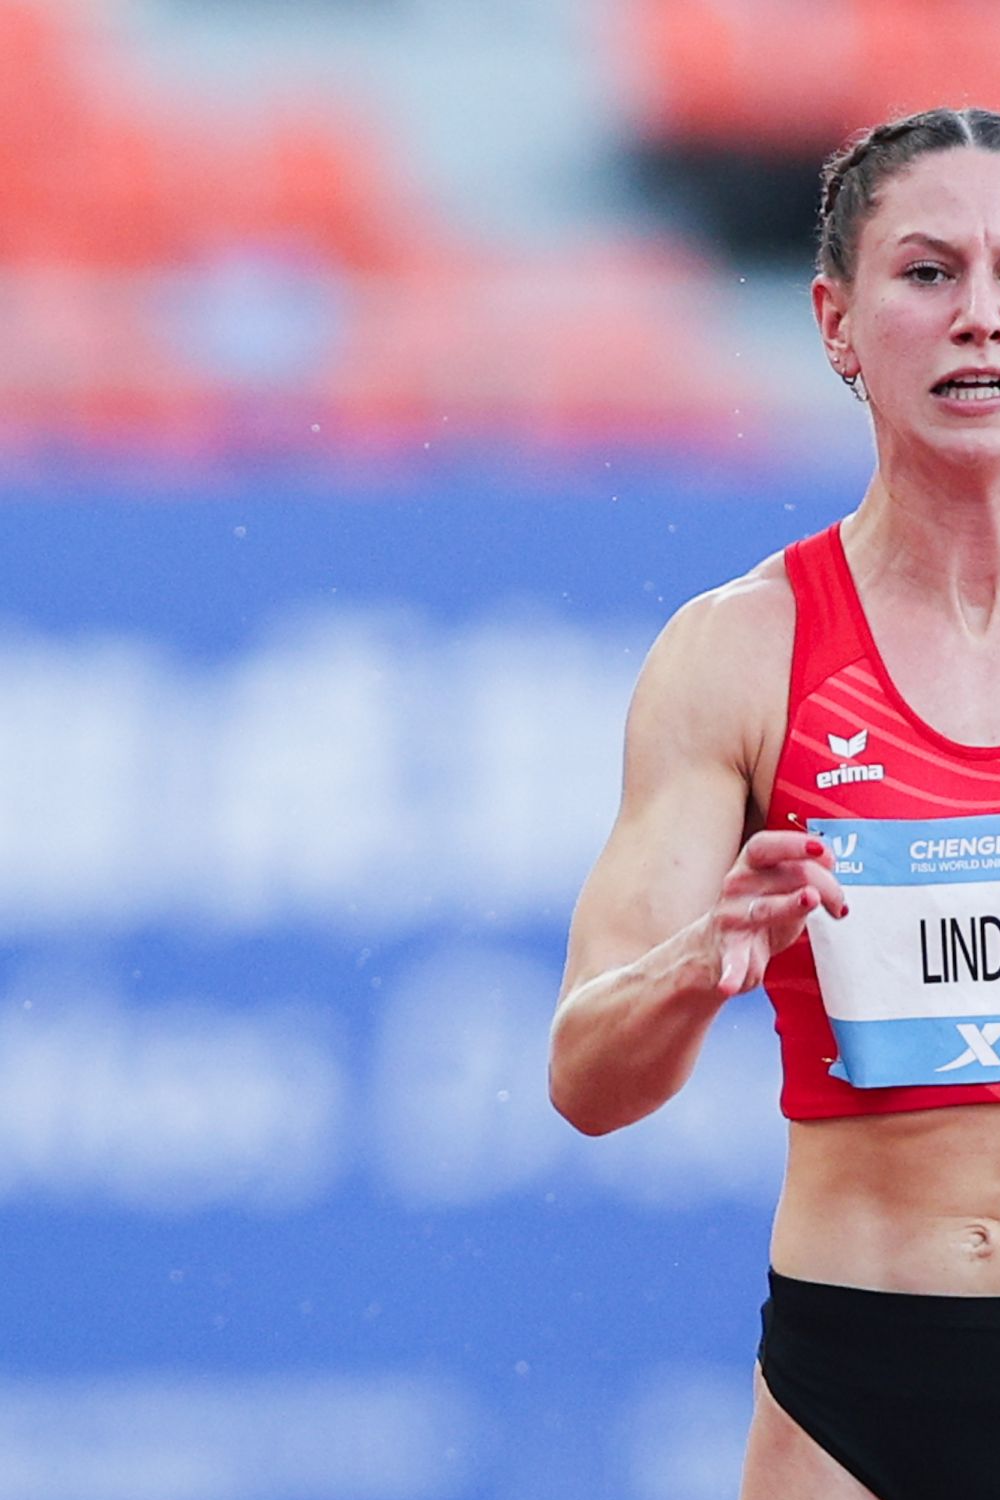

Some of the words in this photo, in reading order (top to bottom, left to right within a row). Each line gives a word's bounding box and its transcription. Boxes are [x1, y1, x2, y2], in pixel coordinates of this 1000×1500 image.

[816, 763, 884, 789] erima
[833, 861, 864, 874] ISU
[911, 862, 936, 873] FISU
[938, 857, 979, 872] WORLD
